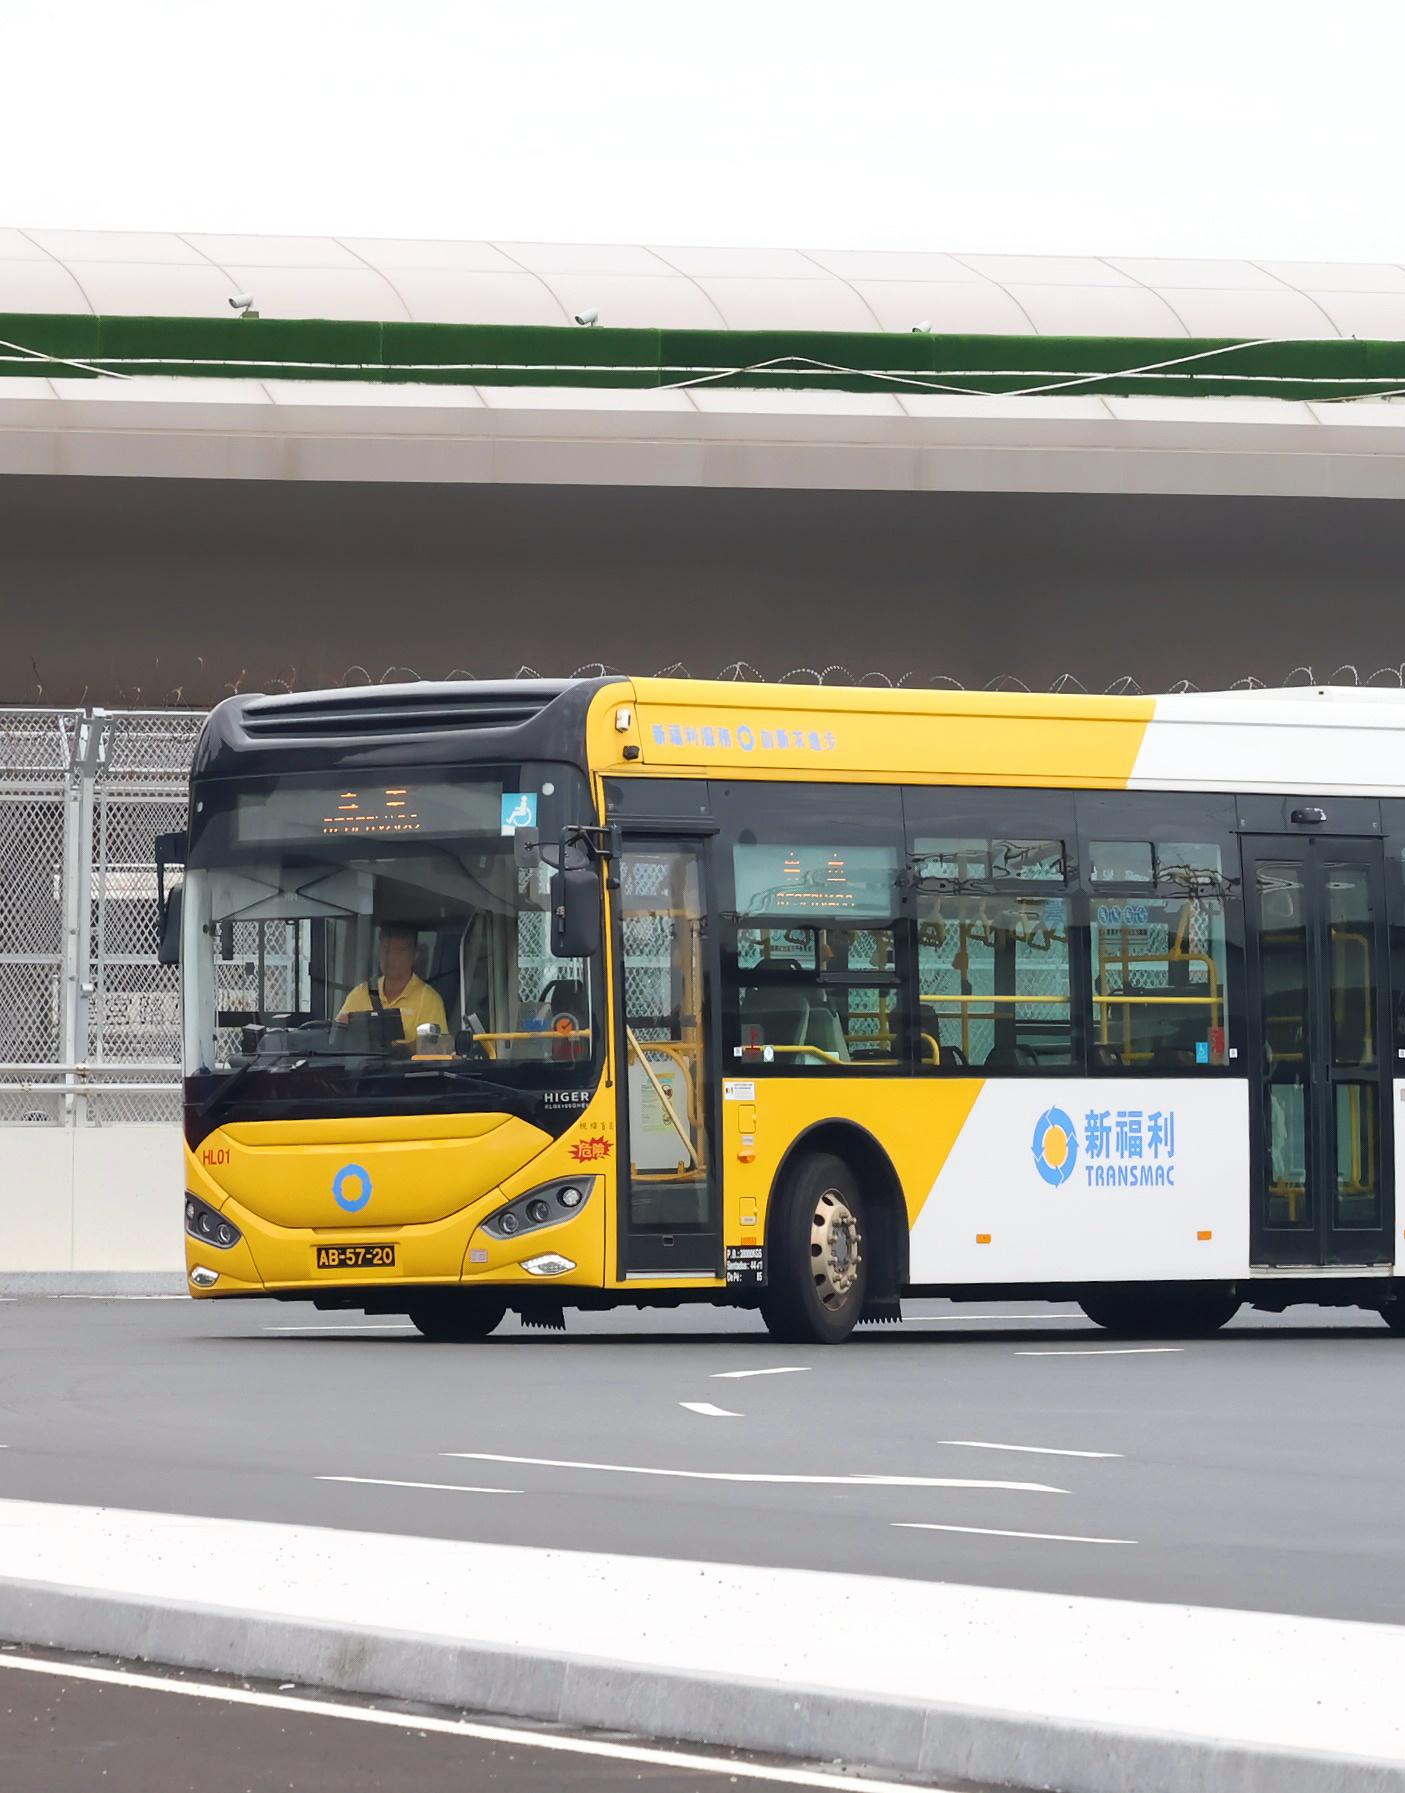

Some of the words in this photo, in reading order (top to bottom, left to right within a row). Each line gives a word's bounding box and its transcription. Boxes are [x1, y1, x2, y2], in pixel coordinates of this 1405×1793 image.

[544, 1091, 589, 1102] HIGER
[1084, 1109, 1175, 1159] 新福利
[202, 1149, 230, 1166] HL01
[578, 1142, 605, 1158] 危險
[1085, 1165, 1175, 1187] TRANSMAC
[319, 1247, 393, 1266] AB-57-20
